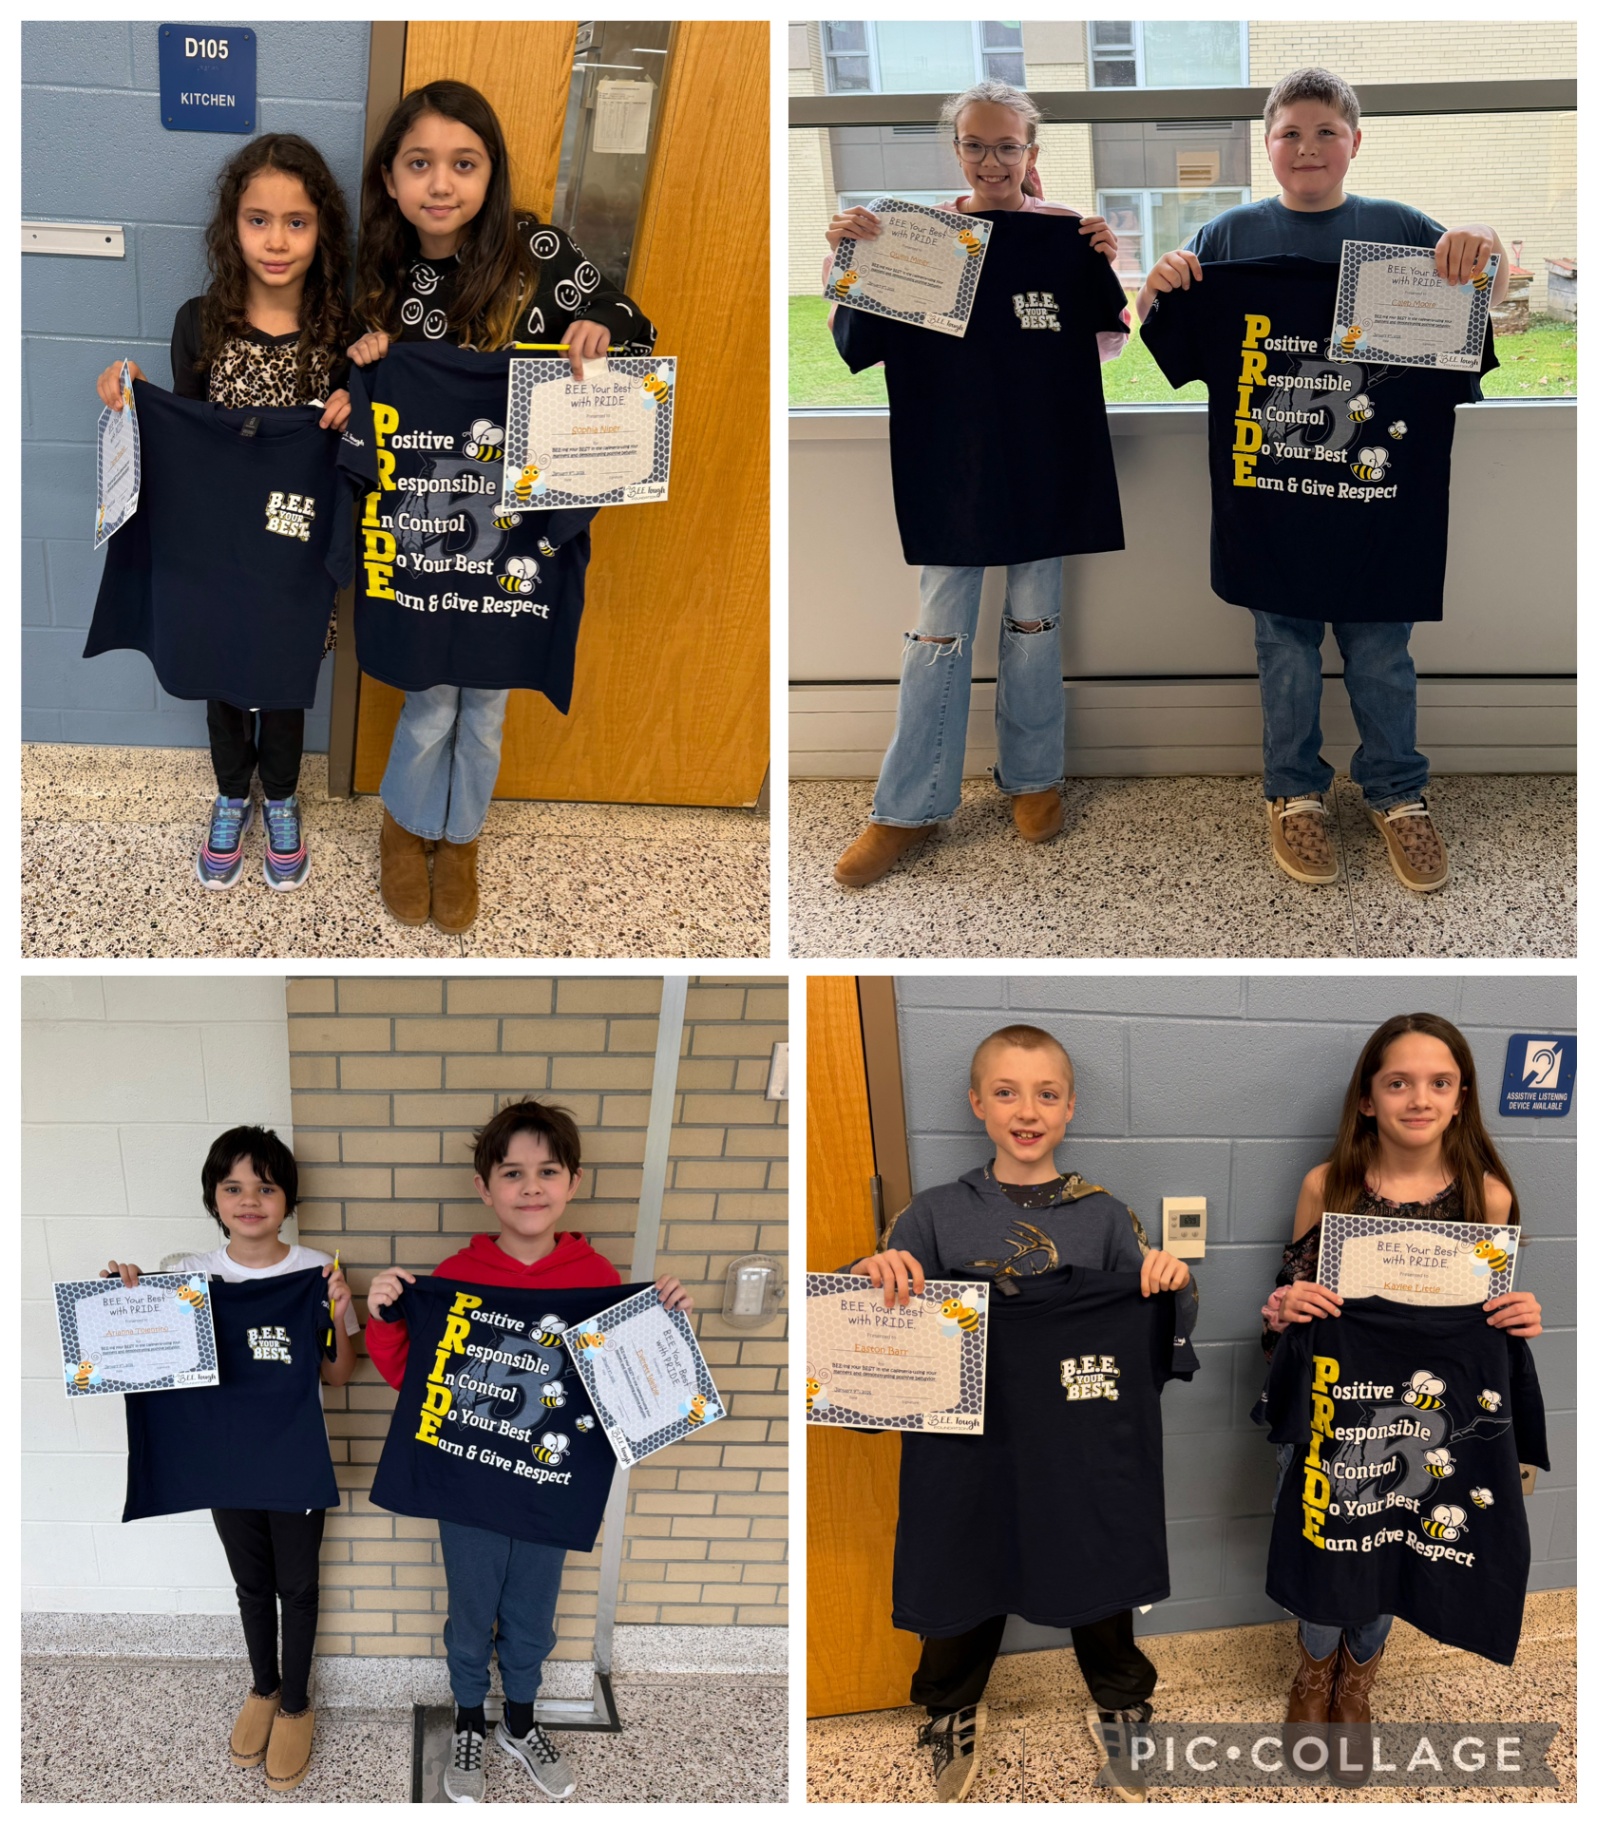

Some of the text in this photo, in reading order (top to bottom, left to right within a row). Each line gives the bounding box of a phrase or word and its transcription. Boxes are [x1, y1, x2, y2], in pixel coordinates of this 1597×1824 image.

[185, 38, 229, 60] D105
[180, 92, 235, 108] KITCHEN
[892, 229, 908, 241] with
[909, 222, 927, 233] Your
[929, 227, 946, 240] Best
[1410, 267, 1430, 276] Your
[1392, 277, 1410, 286] with
[1012, 292, 1059, 310] B.E.E.
[1025, 308, 1047, 316] YOUR
[1021, 314, 1057, 329] BEST
[591, 385, 610, 394] Your
[613, 383, 631, 393] Best
[571, 397, 591, 408] with
[1266, 406, 1325, 425] Control
[1274, 442, 1311, 460] Your
[1314, 444, 1348, 464] Best
[1287, 477, 1298, 492] &
[1302, 479, 1334, 498] Give
[1338, 482, 1398, 503] Respect
[268, 491, 316, 517] B.E.E.
[280, 510, 304, 522] YOUR
[399, 513, 466, 534] Control
[266, 517, 310, 538] BEST
[410, 552, 452, 573] Your
[454, 554, 494, 575] Best
[428, 594, 439, 612] &
[442, 592, 478, 612] Give
[482, 596, 550, 619] Respect
[1506, 1092, 1568, 1100] ASSISTIVE LISTENING
[1509, 1102, 1563, 1110] DEVICE AVAILABLE
[1406, 1244, 1430, 1256] Your
[1434, 1245, 1458, 1257] Best
[1383, 1256, 1406, 1266] with
[125, 1295, 144, 1304] Your
[147, 1294, 166, 1303] Best
[110, 1306, 128, 1316] with
[870, 1303, 895, 1315] Your
[900, 1304, 924, 1317] Best
[848, 1316, 872, 1326] with
[247, 1326, 290, 1342] B.E.E.
[259, 1340, 280, 1348] YOUR
[656, 1340, 669, 1358] with
[854, 1344, 909, 1356] Easton Barr
[253, 1347, 288, 1360] BEST
[672, 1348, 682, 1368] Your
[679, 1368, 690, 1386] Best
[1060, 1355, 1119, 1378] B.E.E.
[1076, 1374, 1104, 1384] YOUR
[458, 1374, 518, 1402] Control
[1067, 1381, 1115, 1400] BEST
[461, 1408, 497, 1432] Your
[498, 1419, 532, 1443] Best
[955, 1416, 980, 1430] Tough
[466, 1446, 478, 1460] &
[479, 1449, 512, 1471] Give
[513, 1459, 572, 1486] Respect
[1334, 1456, 1398, 1480] Control
[1344, 1500, 1384, 1518] Your
[1385, 1491, 1420, 1514] Best
[1362, 1535, 1372, 1552] &
[1374, 1528, 1404, 1548] Give
[1406, 1530, 1476, 1568] Respect
